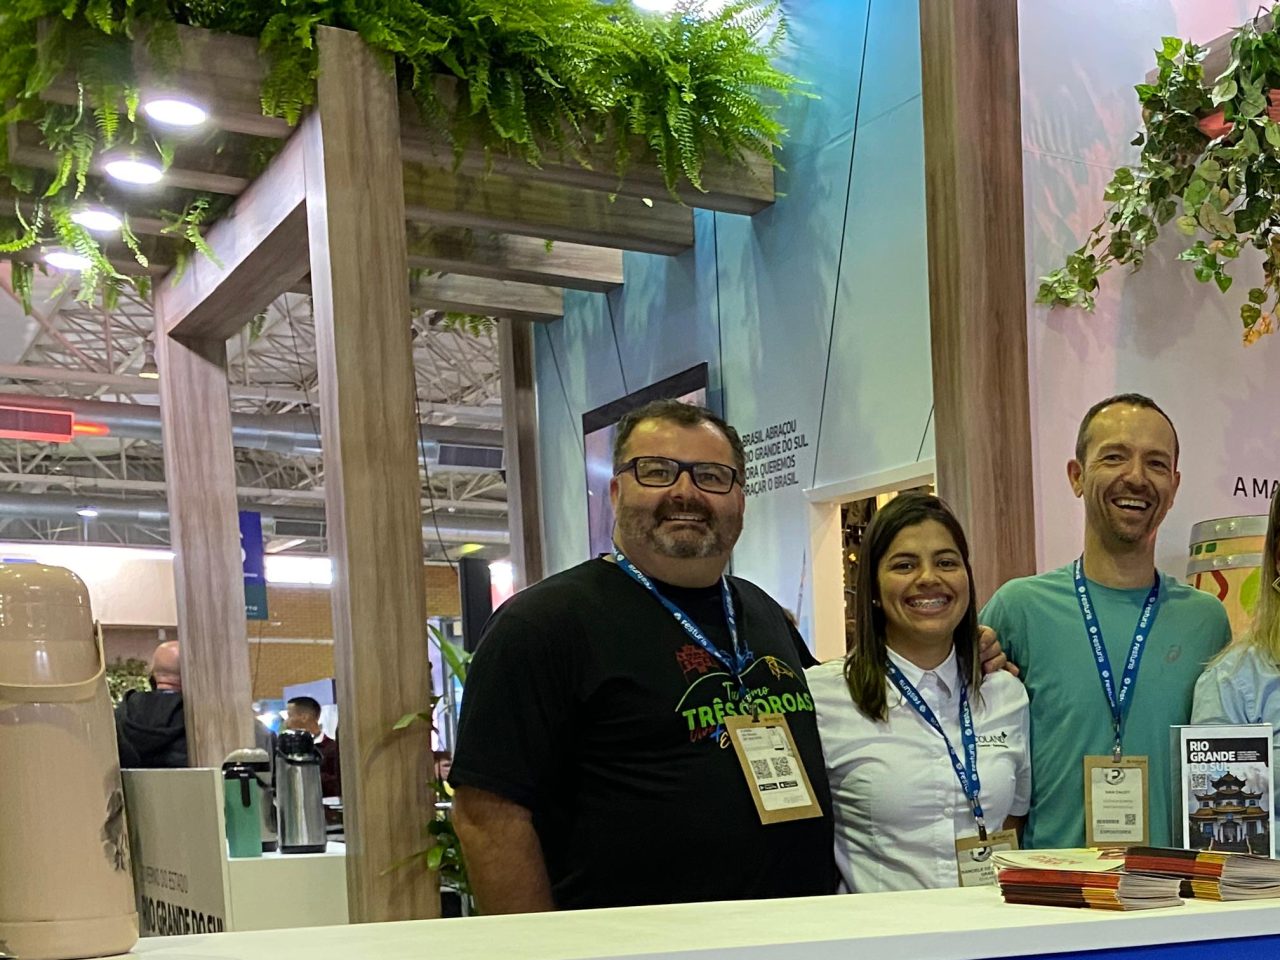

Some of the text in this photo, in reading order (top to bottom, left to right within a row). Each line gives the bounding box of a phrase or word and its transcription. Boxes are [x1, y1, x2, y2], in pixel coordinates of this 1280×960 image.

[742, 419, 797, 448] BRASIL ABRAÇOU
[754, 441, 781, 460] GRANDE
[782, 438, 793, 453] DO
[760, 454, 796, 478] QUEREMOS
[768, 478, 773, 491] O
[1233, 477, 1248, 498] A
[682, 698, 736, 731] TRÊS
[1190, 741, 1210, 752] RIO
[1190, 751, 1236, 762] GRANDE
[1191, 762, 1230, 772] DO SUL
